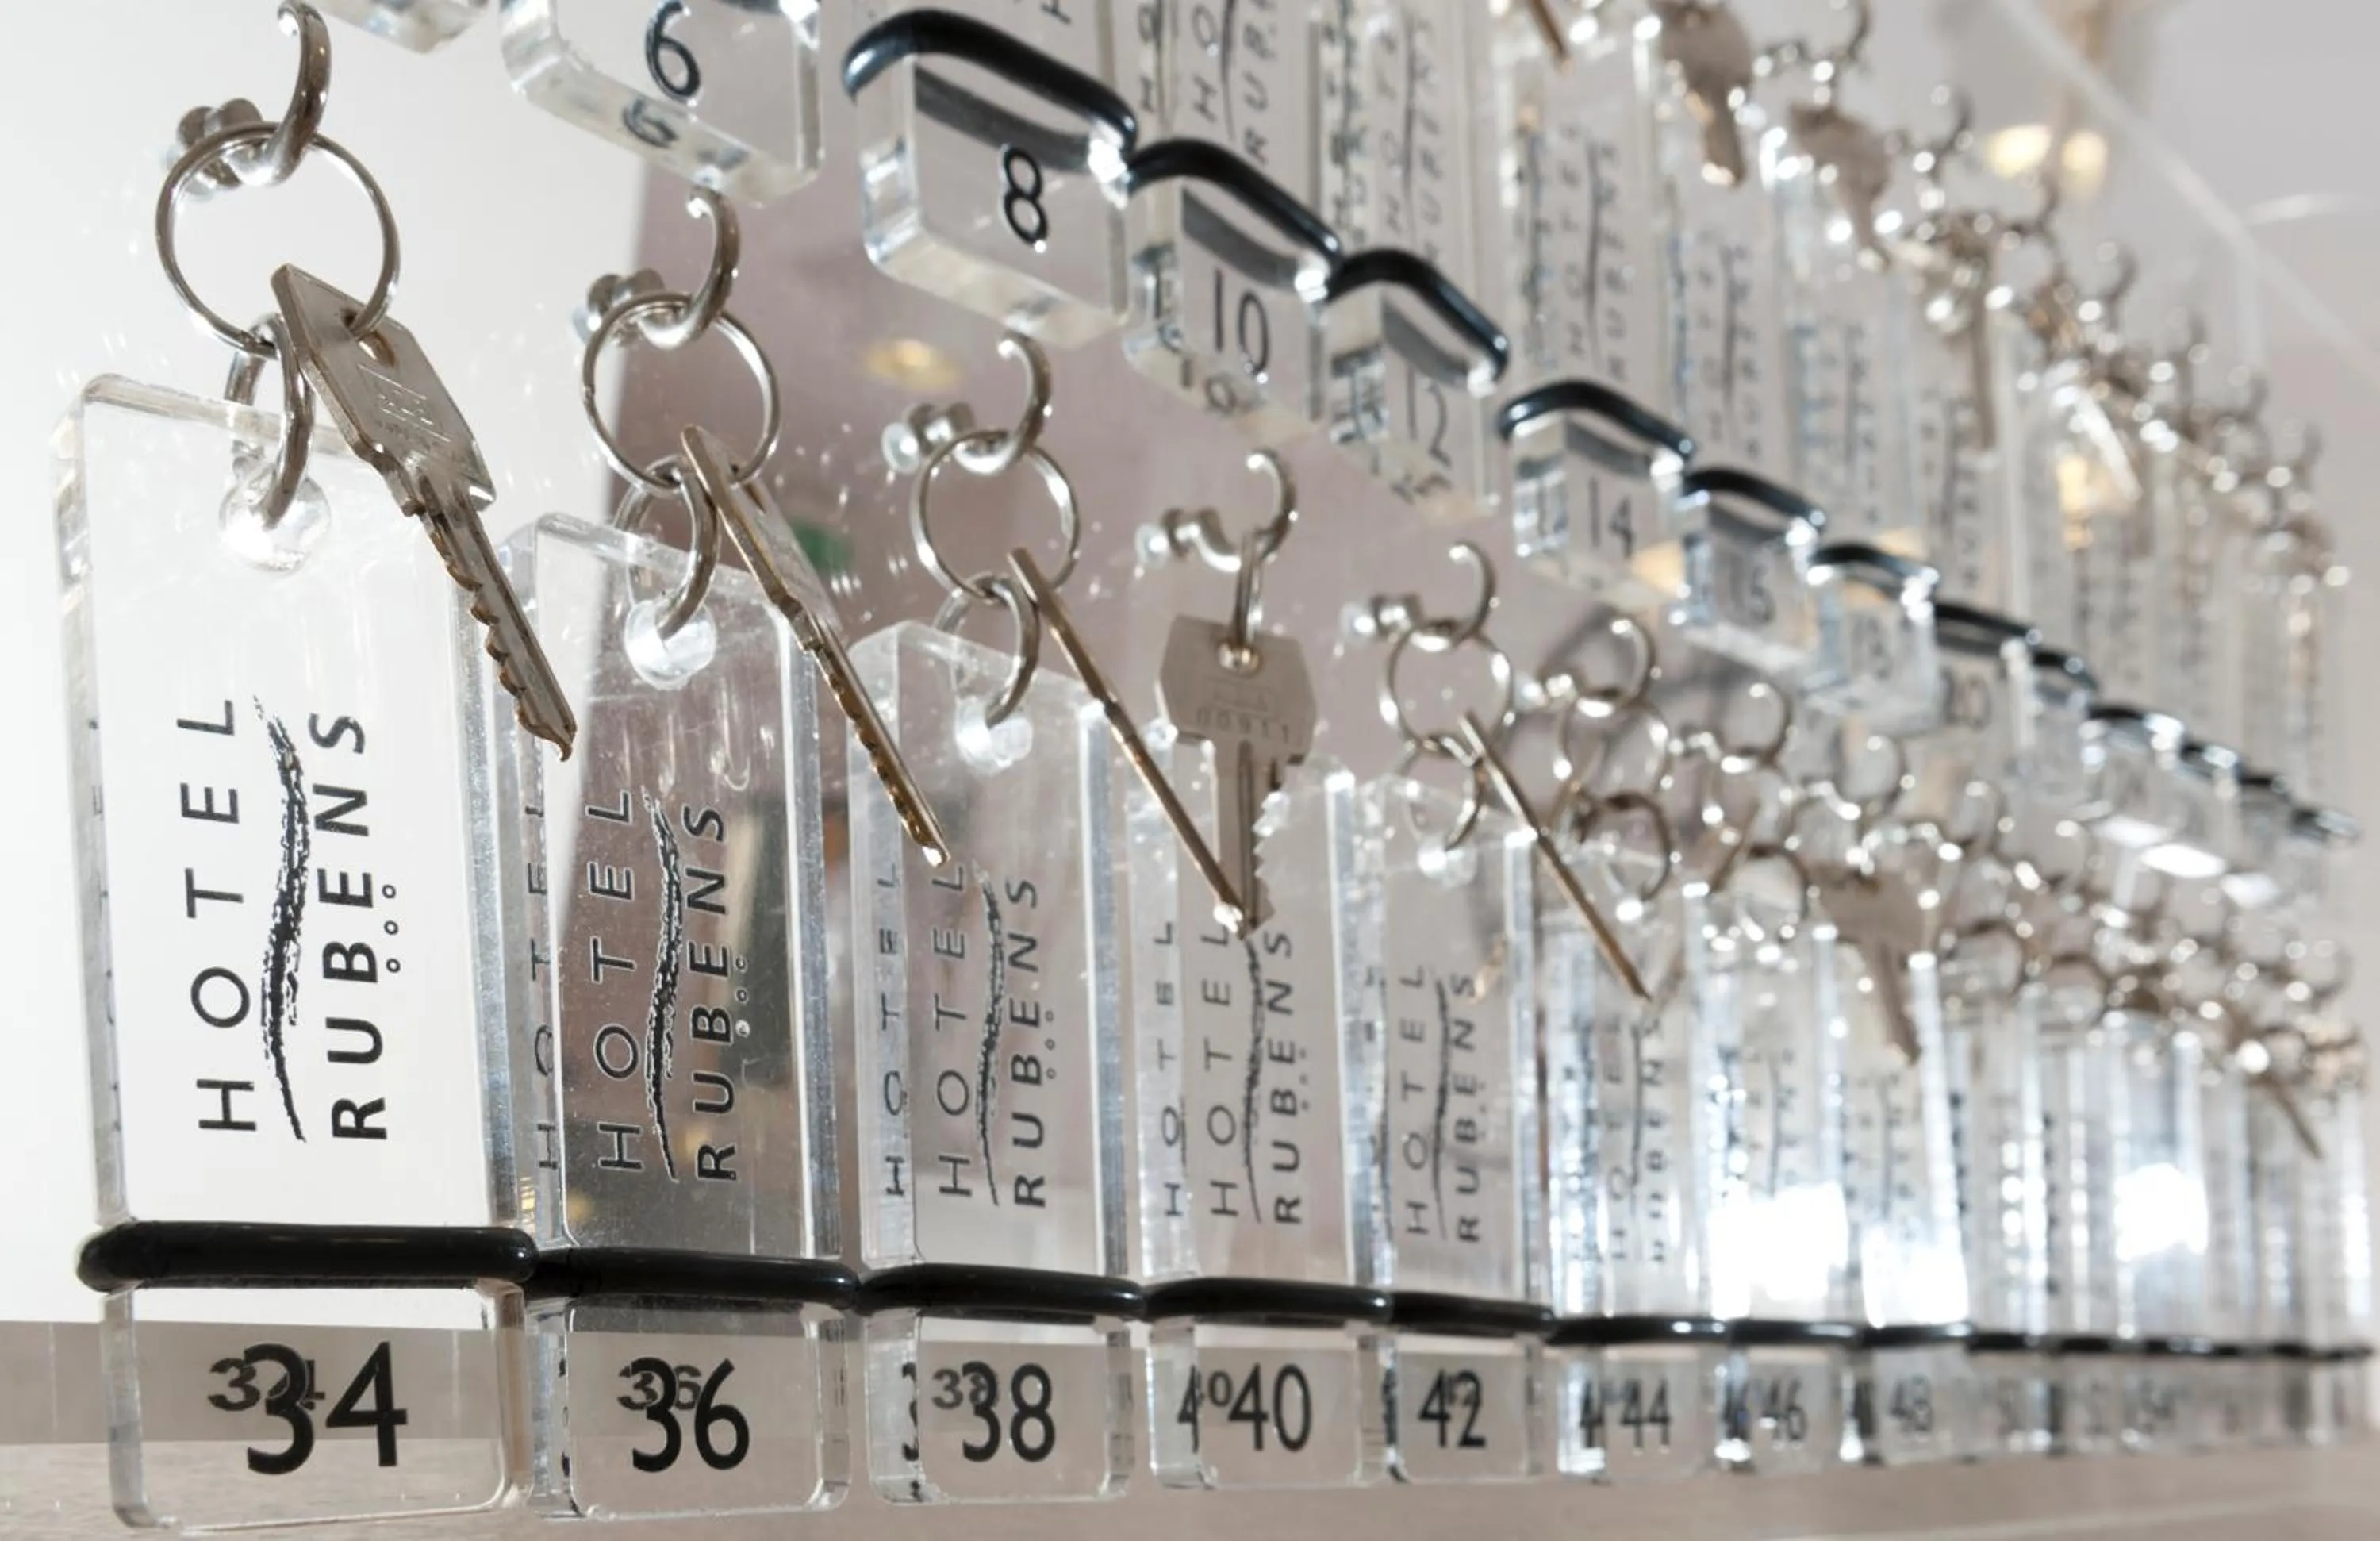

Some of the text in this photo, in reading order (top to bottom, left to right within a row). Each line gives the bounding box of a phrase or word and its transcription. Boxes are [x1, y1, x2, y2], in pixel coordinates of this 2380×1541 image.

[643, 1, 701, 98] 6
[1002, 146, 1049, 244] 8
[1215, 268, 1269, 377] 10
[1588, 476, 1636, 559] 14
[176, 699, 257, 1132] HOTEL
[308, 713, 387, 1140] RUBENS
[586, 790, 643, 1170] HOTEL
[682, 805, 738, 1182] RUBENS
[931, 864, 973, 1198] HOTEL
[1005, 878, 1047, 1208] RUBENS
[1200, 924, 1239, 1217] HOTEL
[1262, 931, 1302, 1224] RUBENS
[1399, 966, 1431, 1236] HOTEL
[1451, 974, 1481, 1243] RUBENS
[244, 1340, 409, 1476] 34
[631, 1356, 750, 1474] 36
[961, 1360, 1057, 1462] 38
[1228, 1362, 1313, 1452] 40
[1418, 1368, 1488, 1450] 42
[1621, 1378, 1672, 1453] 44
